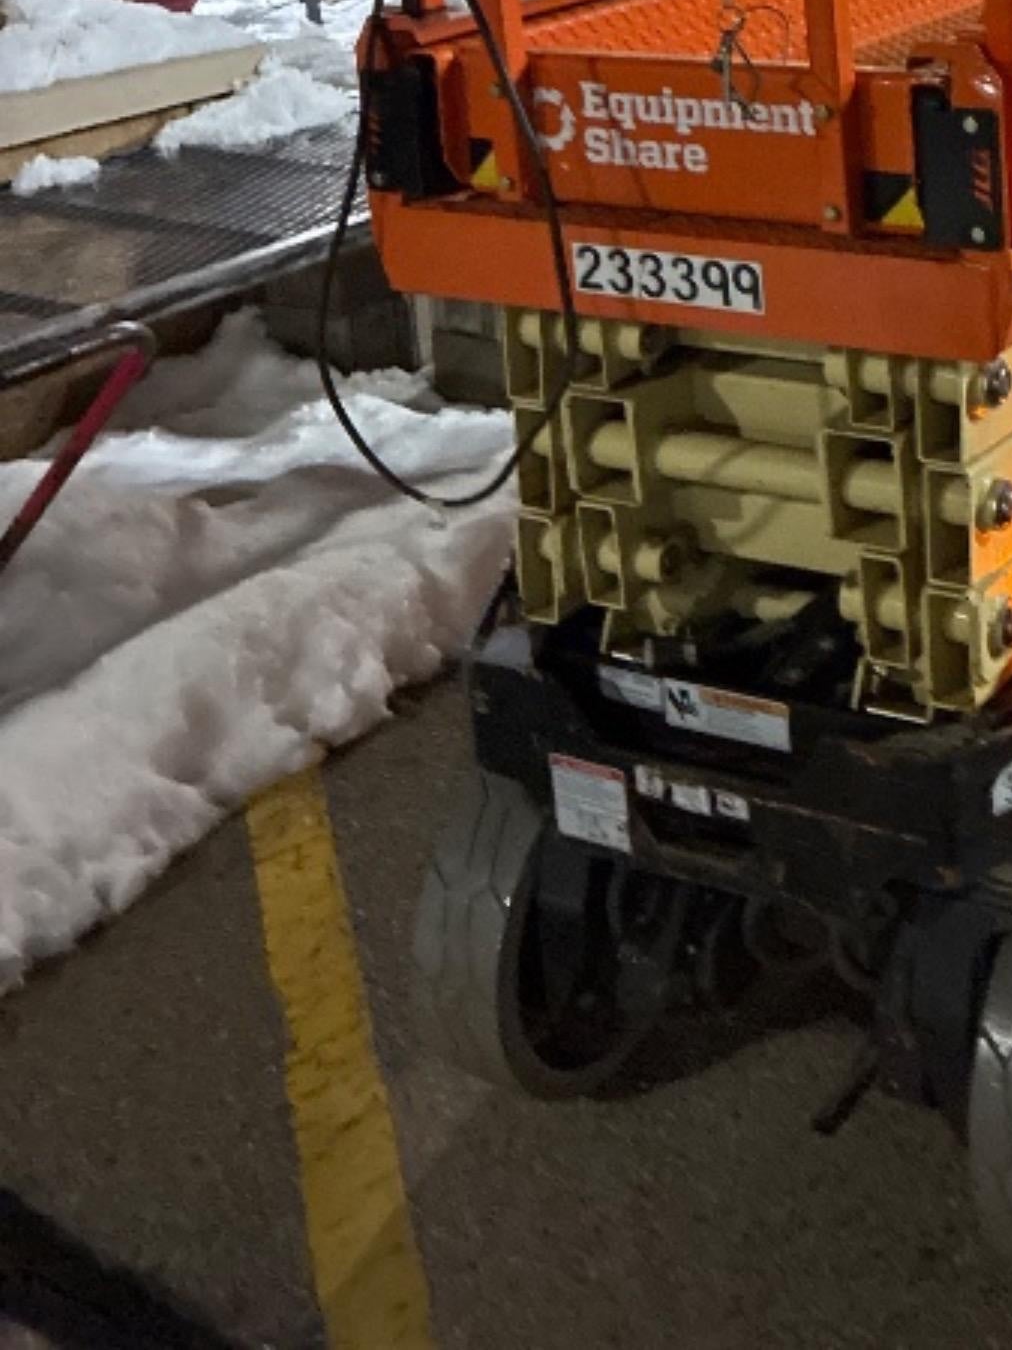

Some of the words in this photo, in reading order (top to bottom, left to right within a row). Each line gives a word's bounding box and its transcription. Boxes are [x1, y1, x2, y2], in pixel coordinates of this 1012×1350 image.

[579, 80, 818, 137] Equipment
[583, 127, 709, 173] Share
[574, 245, 763, 312] 233399
